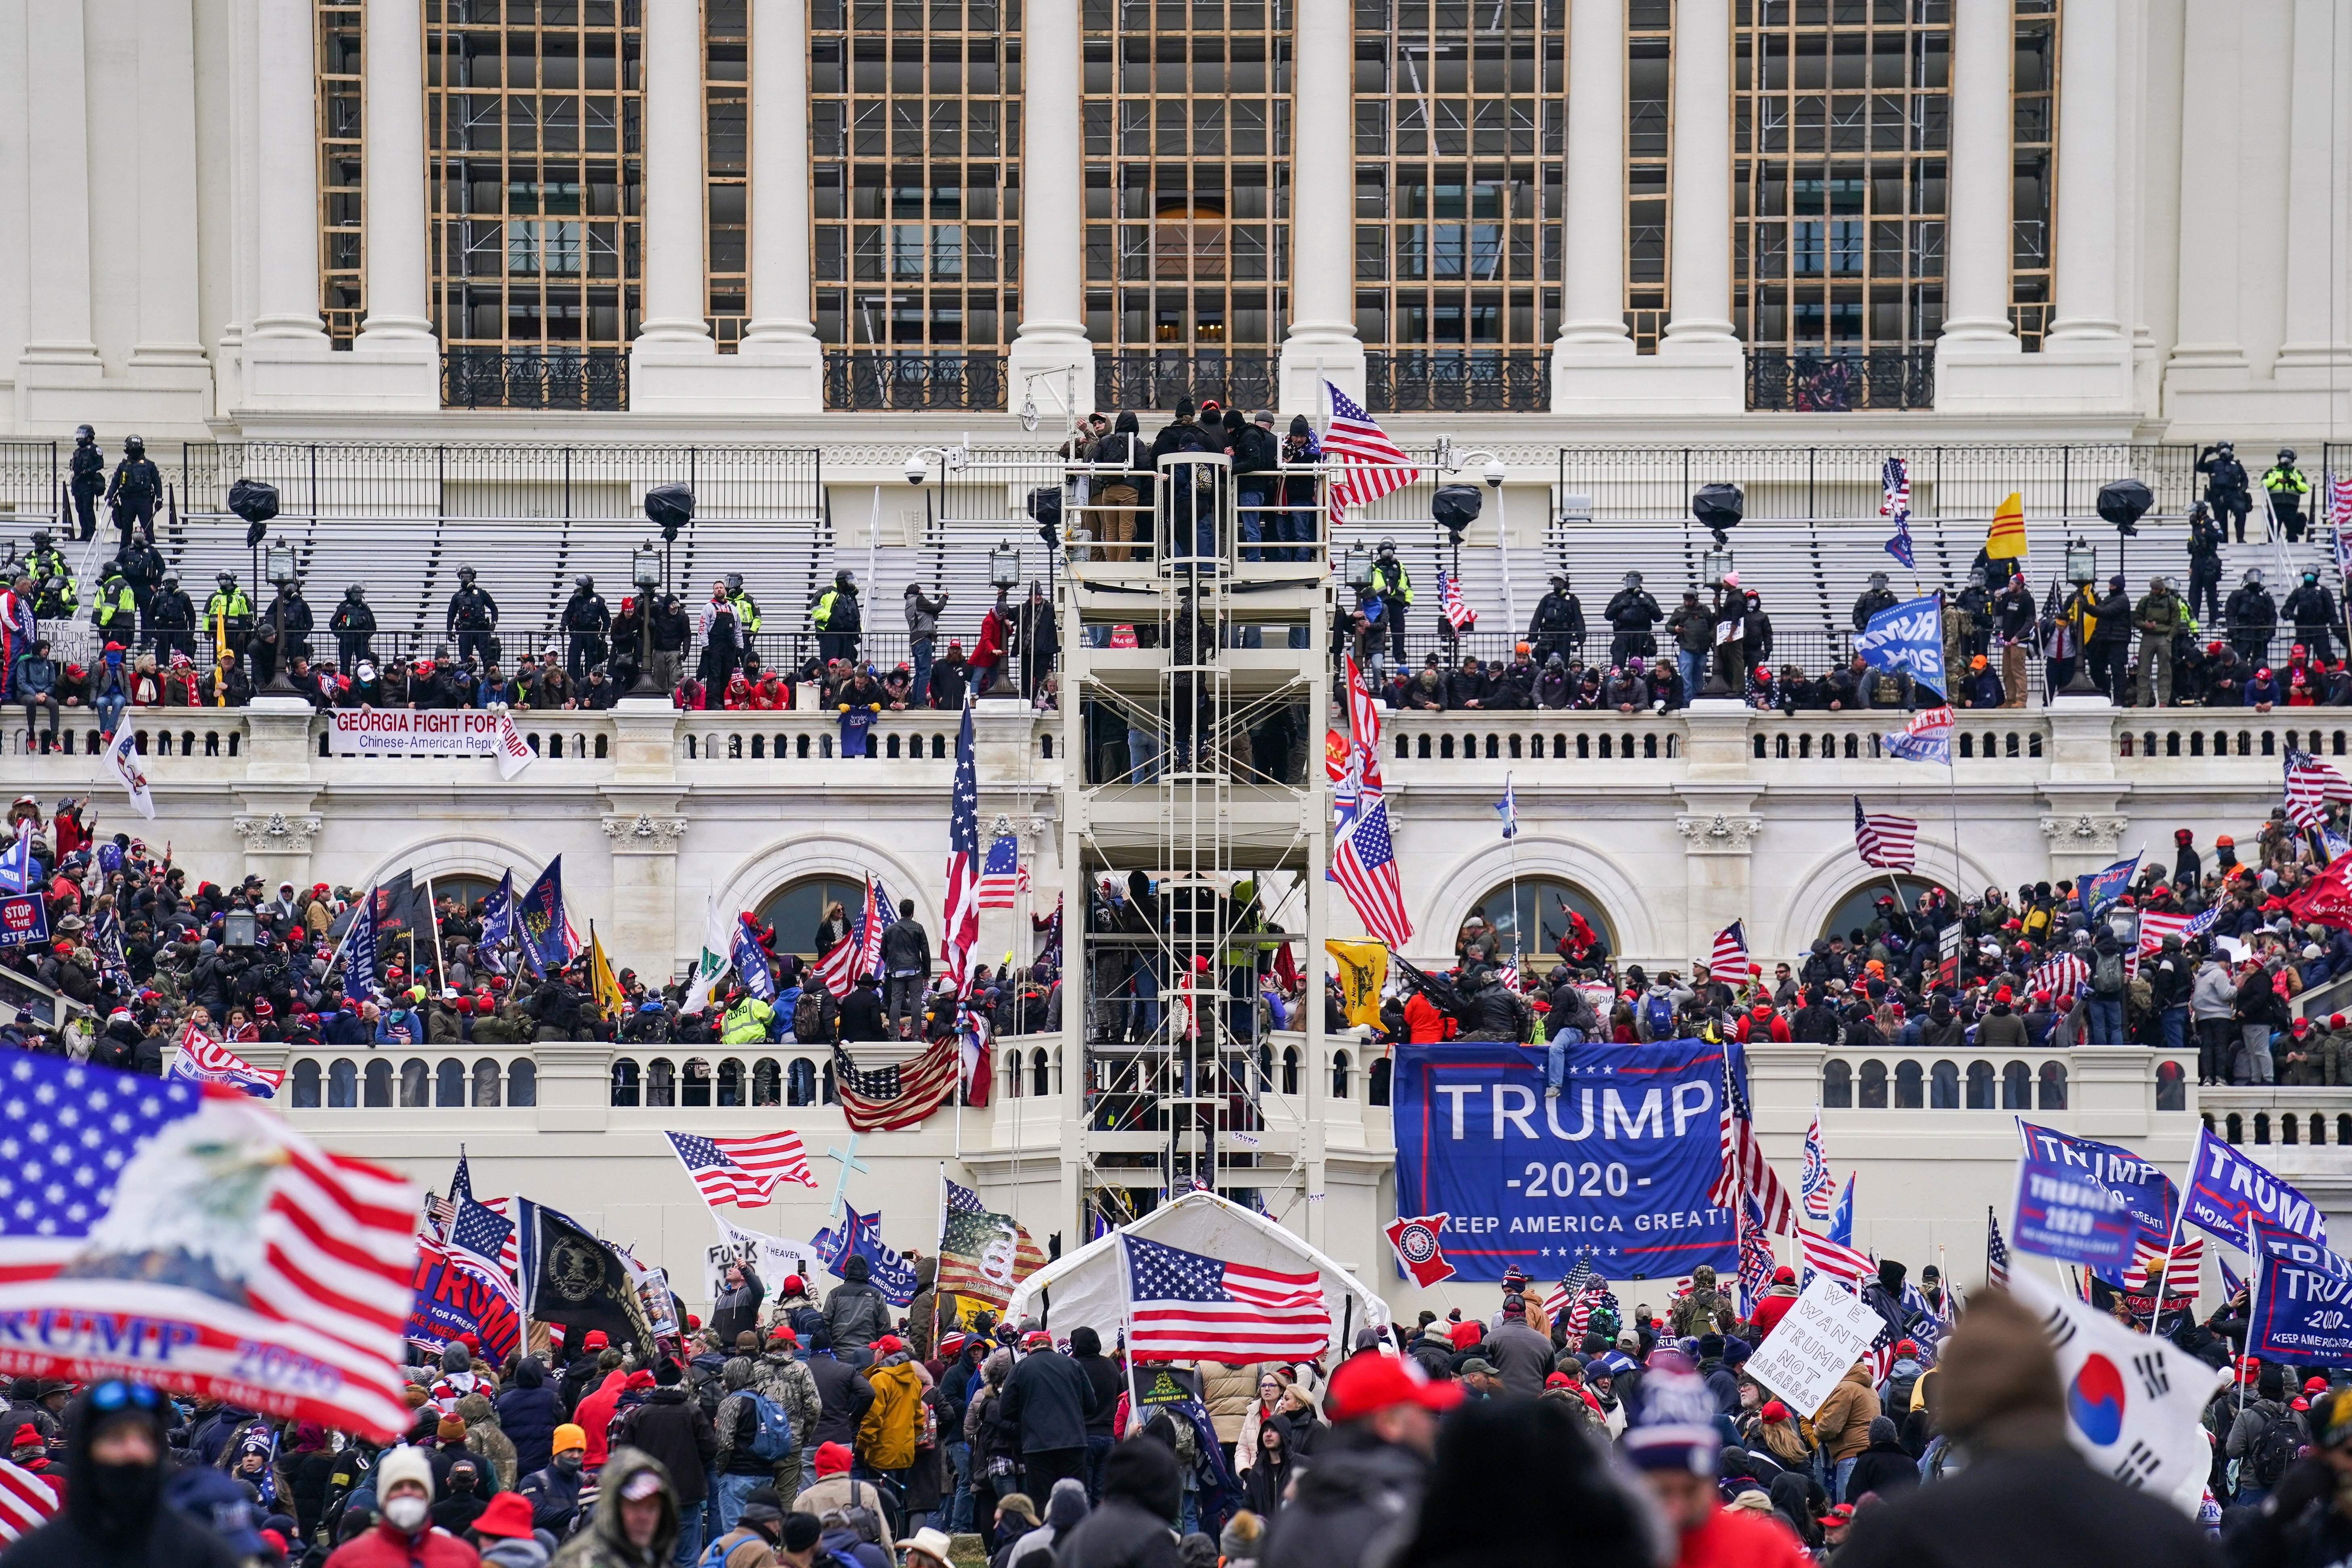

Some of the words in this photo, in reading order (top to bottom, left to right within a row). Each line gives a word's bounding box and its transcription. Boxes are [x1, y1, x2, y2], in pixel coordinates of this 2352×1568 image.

[38, 622, 69, 631] MAKE
[49, 642, 78, 653] REAT
[337, 713, 408, 732] GEORGIA
[414, 714, 460, 733] FIGHT
[465, 715, 497, 733] FOR
[359, 735, 463, 749] Chinese-American
[4, 904, 32, 919] STOP
[10, 918, 31, 928] THE
[2, 929, 44, 943] STEAL
[517, 912, 530, 942] AMERICA
[528, 941, 542, 966] GREAT
[1352, 986, 1357, 994] ON
[1599, 996, 1614, 1004] DIA
[184, 1060, 194, 1072] NO
[193, 1068, 218, 1082] MORE
[1435, 1080, 1714, 1141] TRUMP
[1506, 1161, 1652, 1197] -2020-
[2209, 1143, 2326, 1242] TRUMP
[1509, 1214, 1624, 1234] AMERICA
[1636, 1207, 1728, 1231] GREAT!
[2130, 1210, 2163, 1229] GREAT!
[2195, 1201, 2211, 1220] NO
[771, 1248, 800, 1260] HEAVEN
[869, 1275, 901, 1298] AMERICA
[1824, 1284, 1867, 1323] WE
[431, 1307, 448, 1320] FOR
[449, 1315, 478, 1336] PRESI
[1799, 1300, 1867, 1354] WANT
[2303, 1310, 2351, 1329] -2020-
[426, 1321, 459, 1341] AMERI
[2271, 1333, 2299, 1344] KEEP
[2300, 1334, 2339, 1347] AMERICA
[1782, 1317, 1845, 1373] TRUMP
[1777, 1349, 1820, 1384] NOT
[1749, 1351, 1819, 1408] BARABBAS
